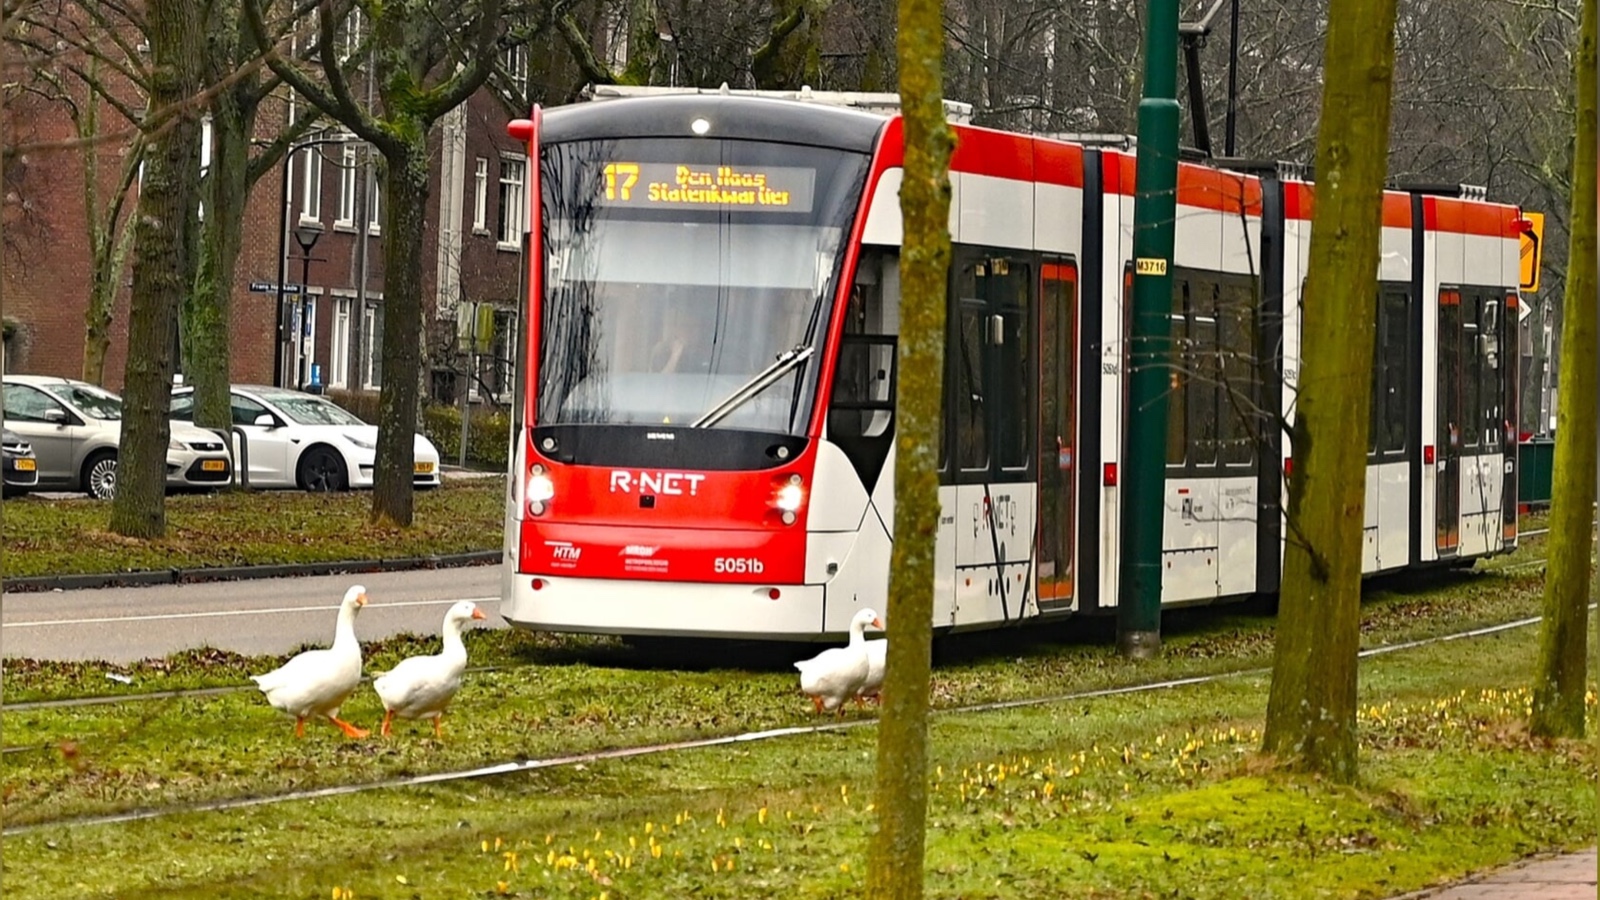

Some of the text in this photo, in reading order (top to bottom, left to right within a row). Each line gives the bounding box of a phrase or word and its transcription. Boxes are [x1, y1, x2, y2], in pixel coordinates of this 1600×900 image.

[603, 162, 640, 201] 17
[675, 164, 712, 185] Den
[1137, 260, 1166, 272] M3716
[553, 546, 582, 560] HTM
[714, 557, 764, 574] 5051b
